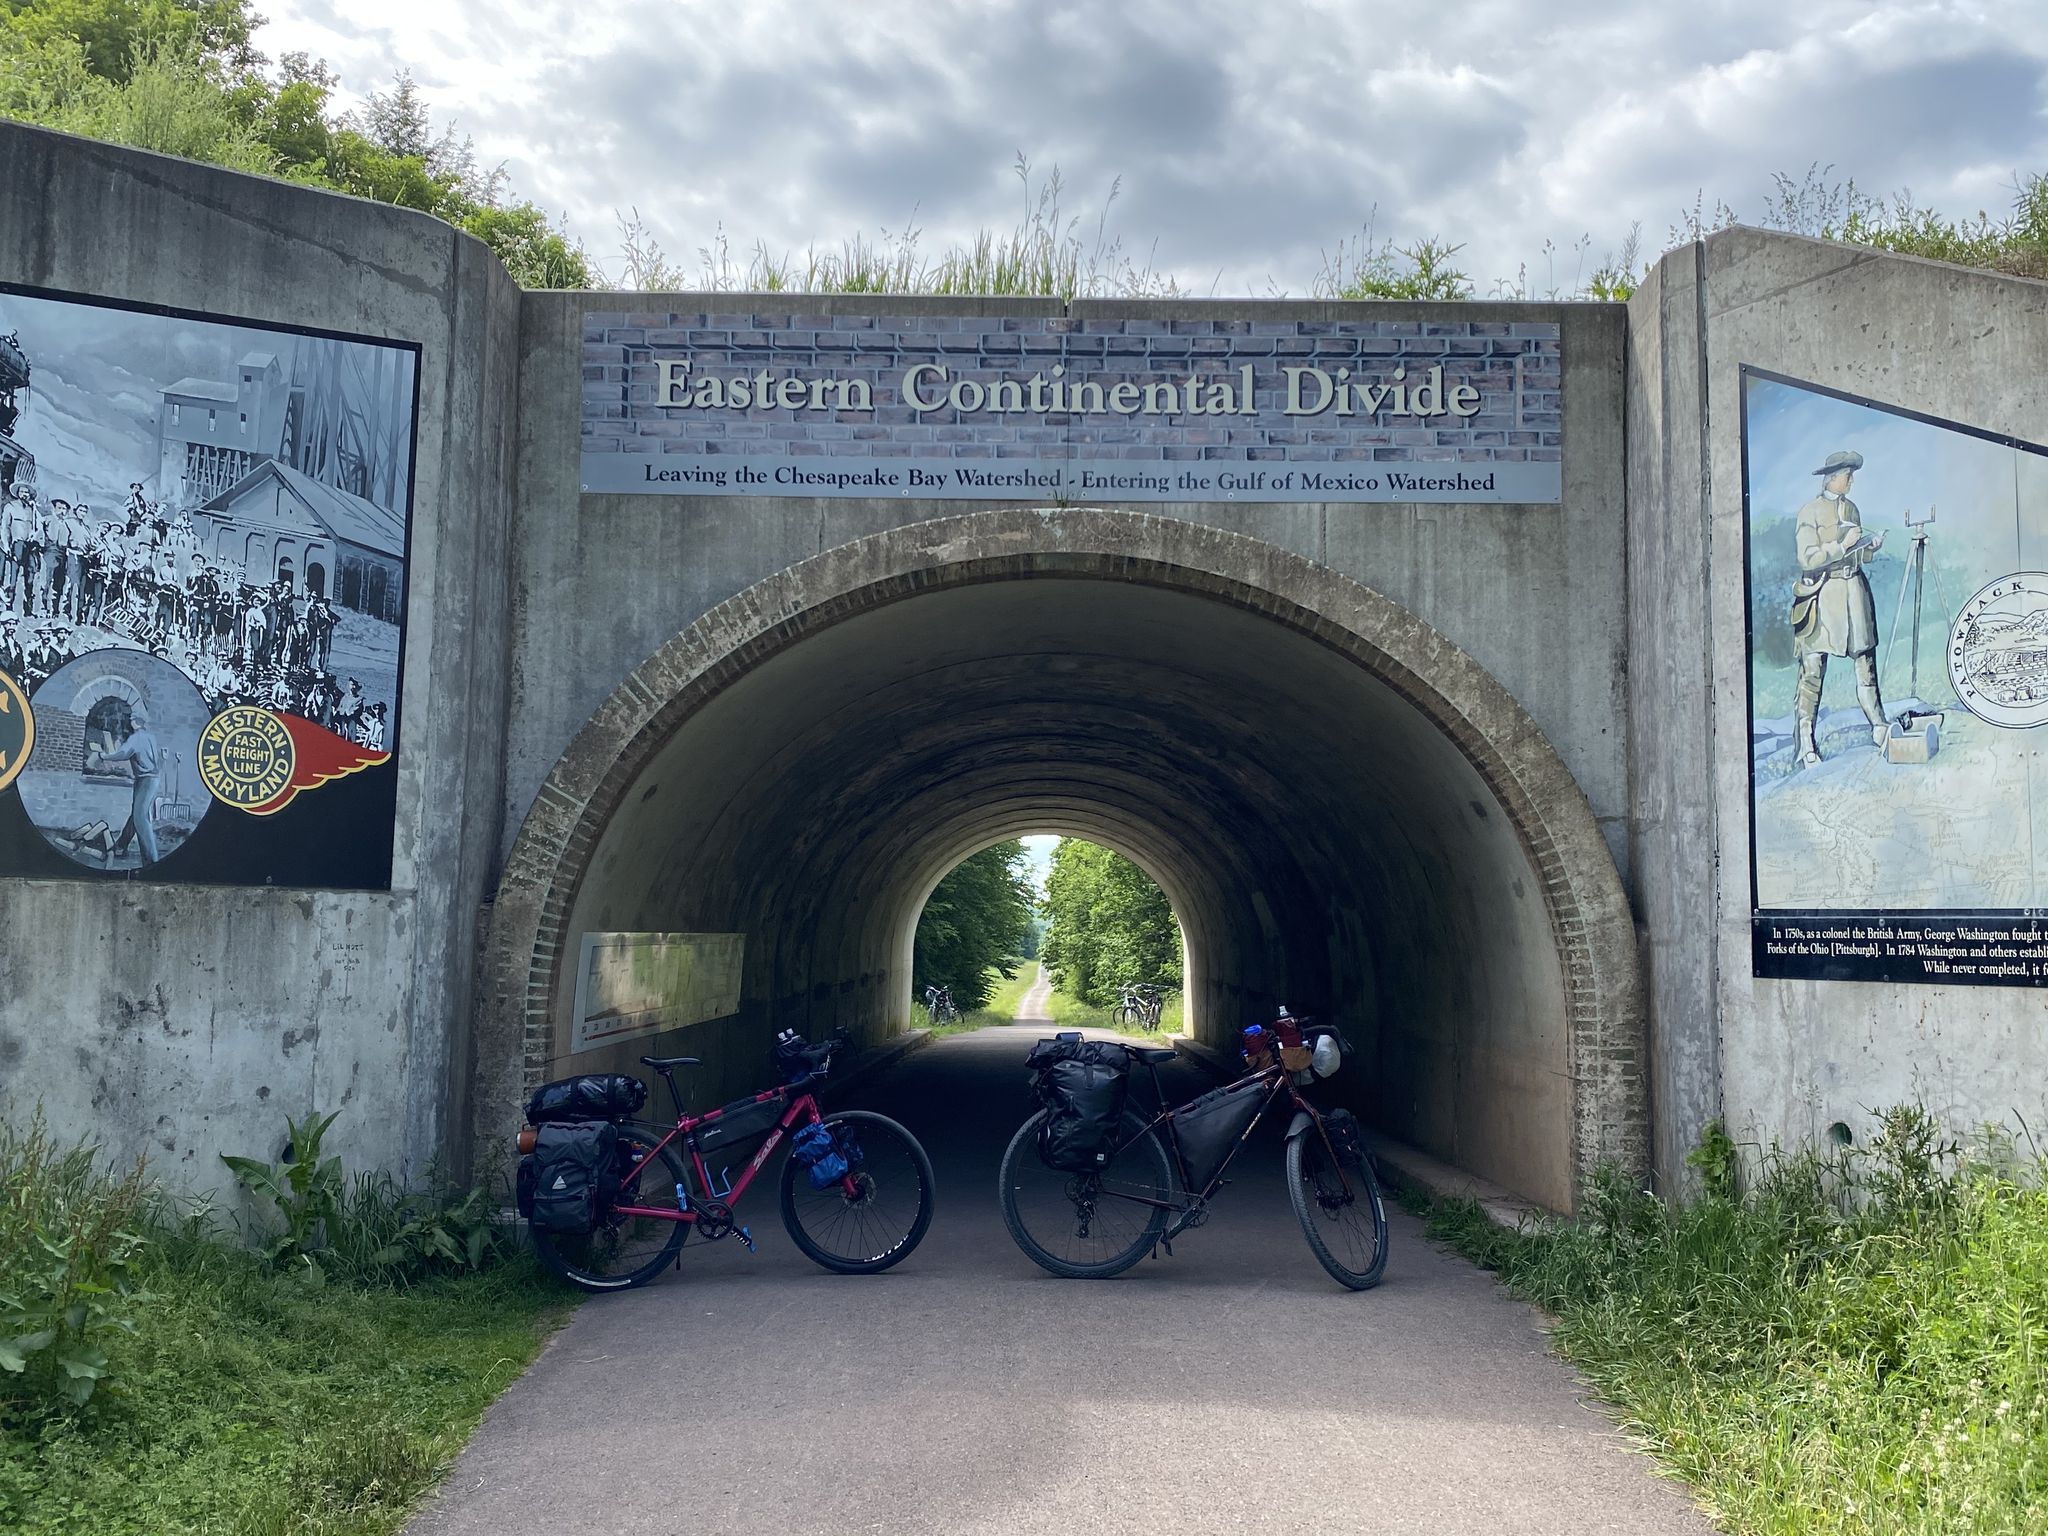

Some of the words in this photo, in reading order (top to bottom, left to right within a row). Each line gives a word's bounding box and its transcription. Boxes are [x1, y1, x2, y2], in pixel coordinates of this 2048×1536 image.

[654, 359, 874, 411] Eastern
[902, 363, 1259, 416] Continental
[1283, 364, 1481, 417] Divide
[645, 465, 726, 487] Leaving
[735, 466, 767, 484] the
[775, 466, 899, 489] Chesapeake
[909, 468, 947, 489] Bay
[955, 469, 1061, 487] Watershed
[1082, 471, 1170, 494] Entering
[1178, 472, 1210, 491] the
[1218, 472, 1267, 491] Gulf
[1271, 473, 1293, 491] of
[1301, 473, 1378, 491] Mexico
[1386, 473, 1495, 491] Watershed
[1954, 581, 2025, 698] PATOWMACK
[207, 711, 287, 749] WESTERN
[235, 734, 262, 748] FAST
[226, 746, 269, 762] FREIGHT
[233, 761, 260, 775] LINE
[203, 754, 289, 801] MARYLAND
[1773, 927, 1781, 939] In
[1785, 927, 1805, 940] 1750s,
[1806, 930, 1815, 939] as
[1815, 930, 1821, 939] a
[1822, 926, 1850, 939] colonel
[1852, 926, 1865, 939] the
[1867, 926, 1894, 939] British
[1896, 927, 1922, 942] Army,
[1924, 927, 1956, 943] George
[1956, 927, 2010, 943] Washington
[2012, 927, 2042, 943] fought
[1767, 942, 1787, 954] Forks
[1788, 942, 1797, 954] of
[1797, 942, 1809, 954] the
[1810, 942, 1829, 955] Ohio
[1831, 942, 1882, 958] [Pittsburgh].
[1886, 943, 1896, 956] In
[1898, 944, 1915, 956] 1784
[1917, 944, 1968, 959] Washington
[1970, 944, 1987, 957] and
[1989, 944, 2018, 957] others
[1923, 960, 1950, 973] While
[1952, 965, 1977, 974] never
[1979, 961, 2029, 977] completed,
[2032, 963, 2040, 975] it
